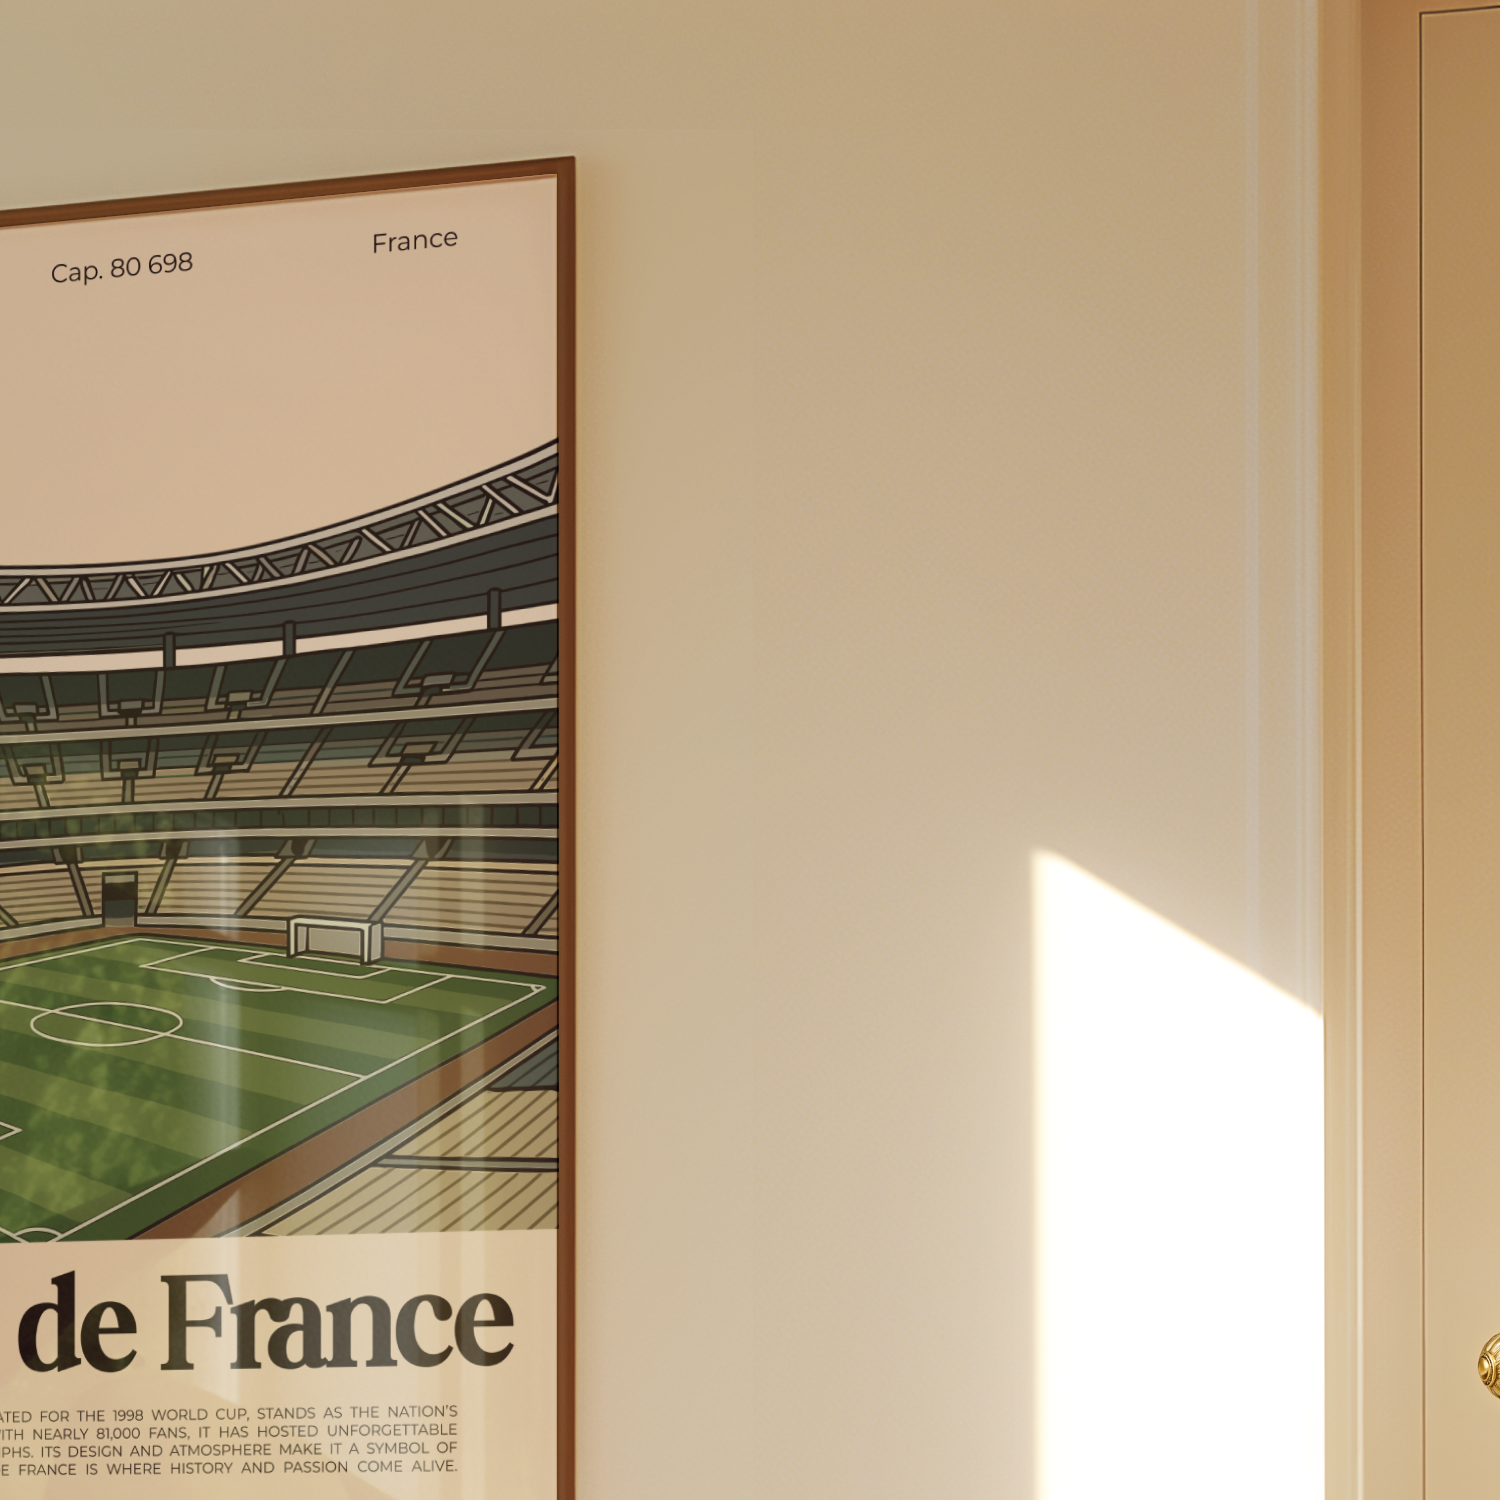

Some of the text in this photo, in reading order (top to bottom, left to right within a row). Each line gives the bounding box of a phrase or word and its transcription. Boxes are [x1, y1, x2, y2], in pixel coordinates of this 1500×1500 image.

[374, 231, 458, 253] France
[52, 252, 193, 286] Cap. 80 698
[18, 1270, 137, 1373] de
[161, 1274, 514, 1370] France
[40, 1410, 70, 1423] FOR
[76, 1409, 106, 1423] THE
[112, 1409, 144, 1422] 1998
[151, 1408, 209, 1422] WORLD
[215, 1407, 250, 1422] CUP,
[257, 1406, 316, 1420] STANDS
[323, 1406, 343, 1419] AS
[350, 1406, 379, 1419] THE
[388, 1404, 459, 1418] NATION’S
[32, 1427, 89, 1441] NEARLY
[96, 1426, 141, 1441] 81,000
[149, 1426, 191, 1440] FANS,
[198, 1426, 211, 1439] IT
[219, 1425, 249, 1439] HAS
[257, 1424, 319, 1438] HOSTED
[327, 1422, 458, 1437] UNFORGETTABLE
[41, 1445, 62, 1459] ITS
[68, 1445, 123, 1458] DESIGN
[129, 1444, 163, 1458] AND
[169, 1443, 272, 1457] ATMOSPHERE
[279, 1442, 322, 1456] MAKE
[330, 1442, 343, 1455] IT
[348, 1442, 360, 1455] A
[366, 1441, 430, 1455] SYMBOL
[436, 1441, 458, 1454] OF
[18, 1463, 77, 1476] FRANCE
[86, 1462, 99, 1476] IS
[106, 1462, 162, 1476] WHERE
[170, 1461, 234, 1475] HISTORY
[240, 1461, 275, 1474] AND
[283, 1460, 348, 1474] PASSION
[357, 1460, 403, 1473] COME
[411, 1459, 458, 1473] ALIVE.
